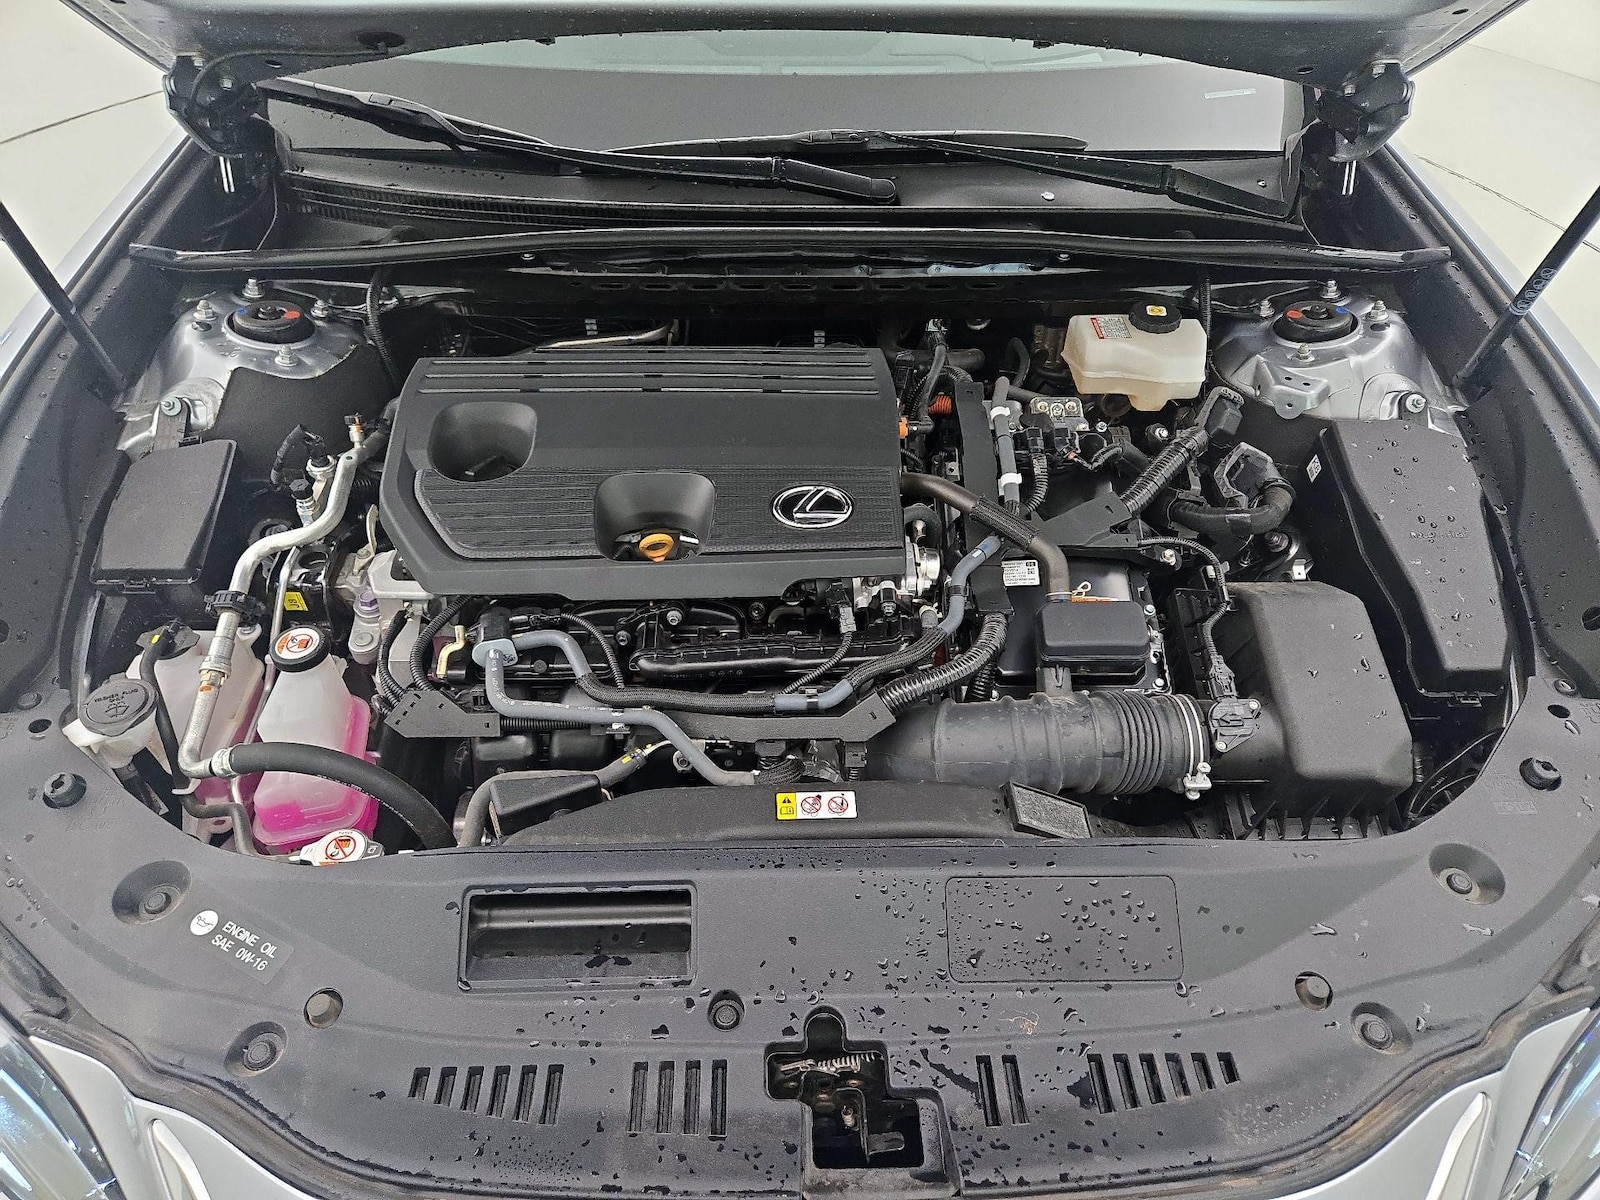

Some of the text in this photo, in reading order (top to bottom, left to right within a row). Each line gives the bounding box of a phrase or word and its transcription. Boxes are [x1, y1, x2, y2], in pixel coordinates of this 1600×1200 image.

[211, 934, 268, 971] SAE 0W-16
[222, 921, 278, 959] ENGINE OIL
